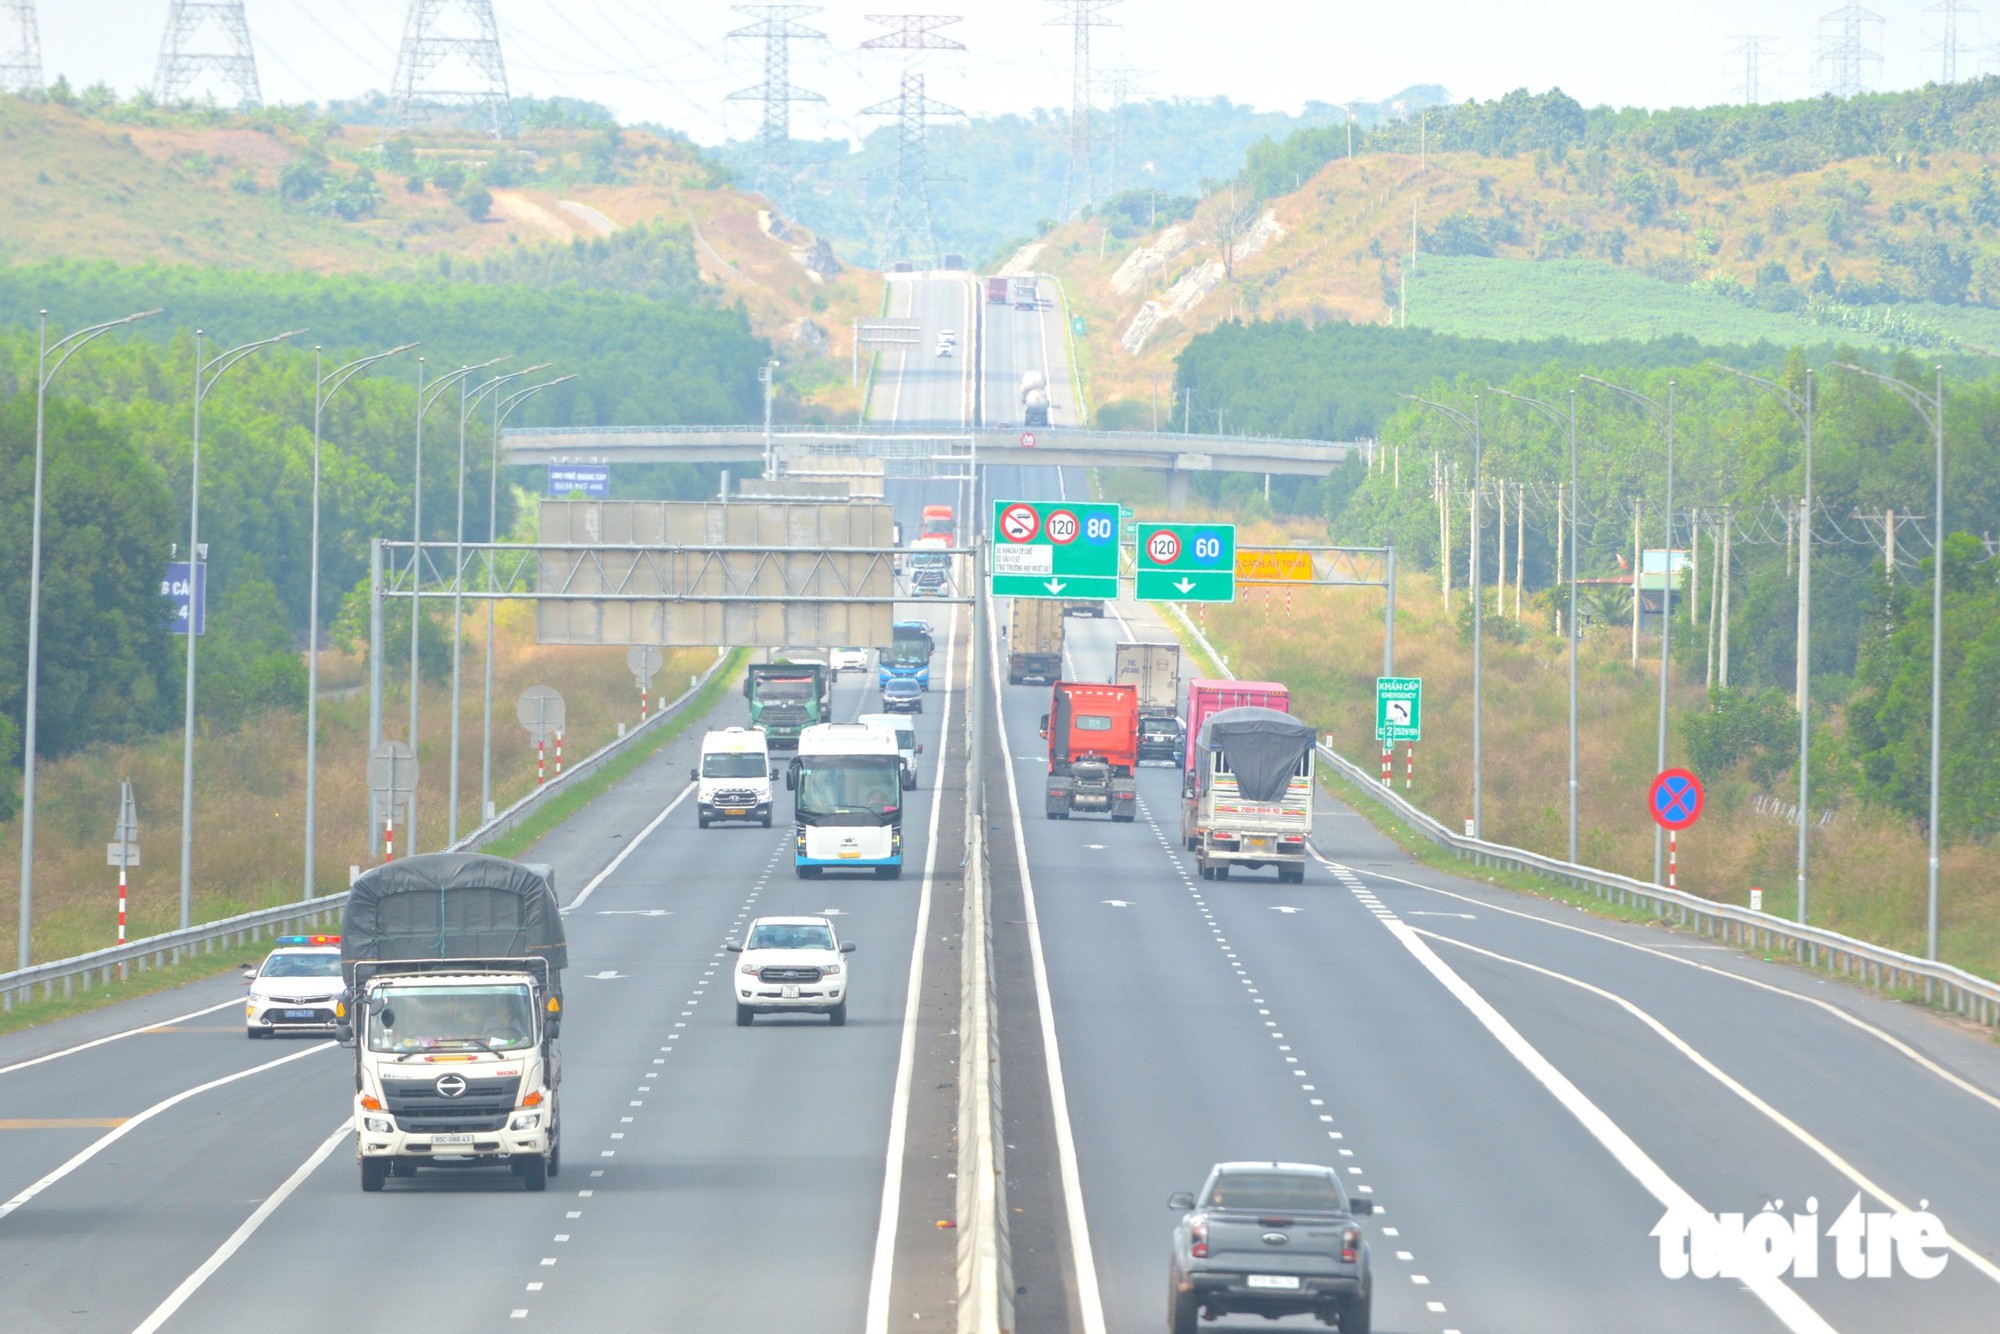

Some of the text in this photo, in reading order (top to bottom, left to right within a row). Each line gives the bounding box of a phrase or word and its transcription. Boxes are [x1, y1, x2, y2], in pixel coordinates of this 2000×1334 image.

[1052, 519, 1074, 535] 120
[1087, 518, 1111, 538] 80
[1153, 540, 1175, 555] 120
[1196, 538, 1220, 558] 60
[1403, 680, 1418, 691] CẤP
[1386, 738, 1393, 748] 8
